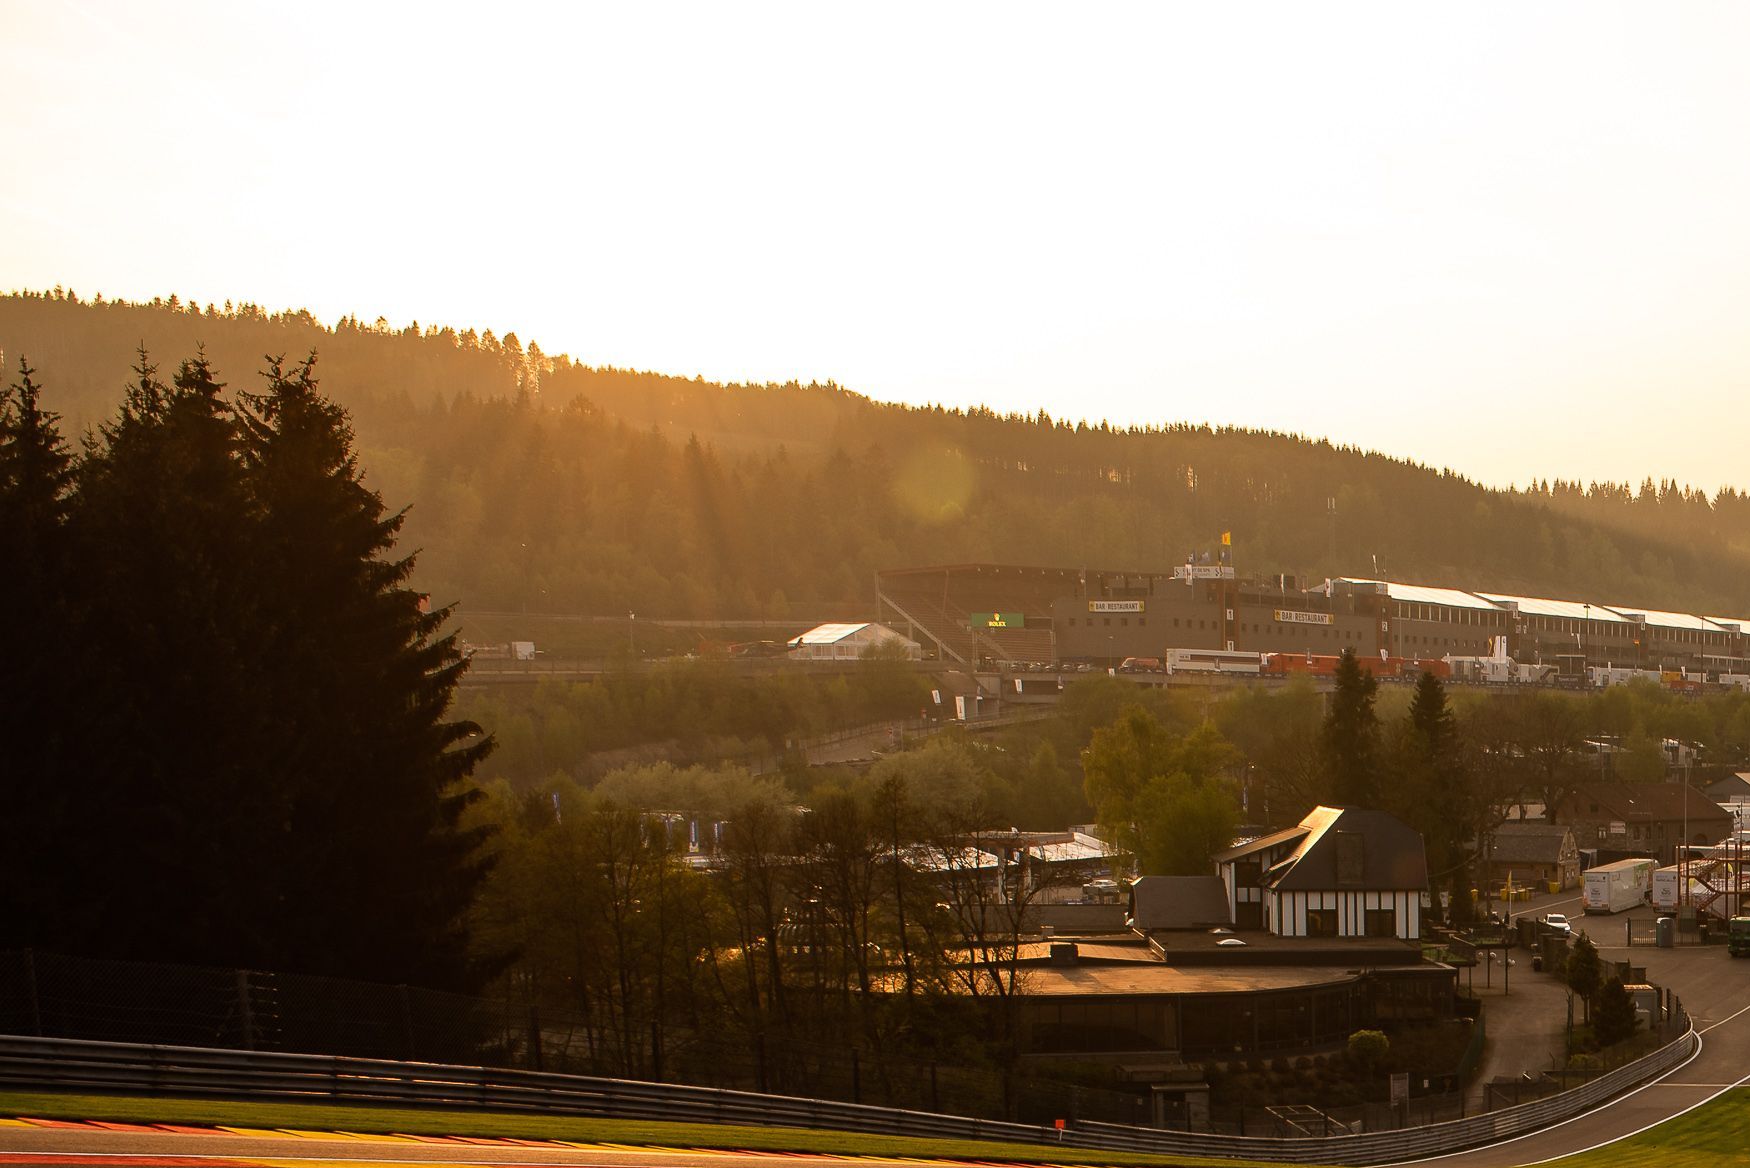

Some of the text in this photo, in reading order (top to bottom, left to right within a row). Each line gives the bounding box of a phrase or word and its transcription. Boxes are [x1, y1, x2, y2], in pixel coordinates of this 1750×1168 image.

[1095, 602, 1138, 610] BAR RESTAURANT
[1281, 611, 1328, 624] BAR RESTAURANT
